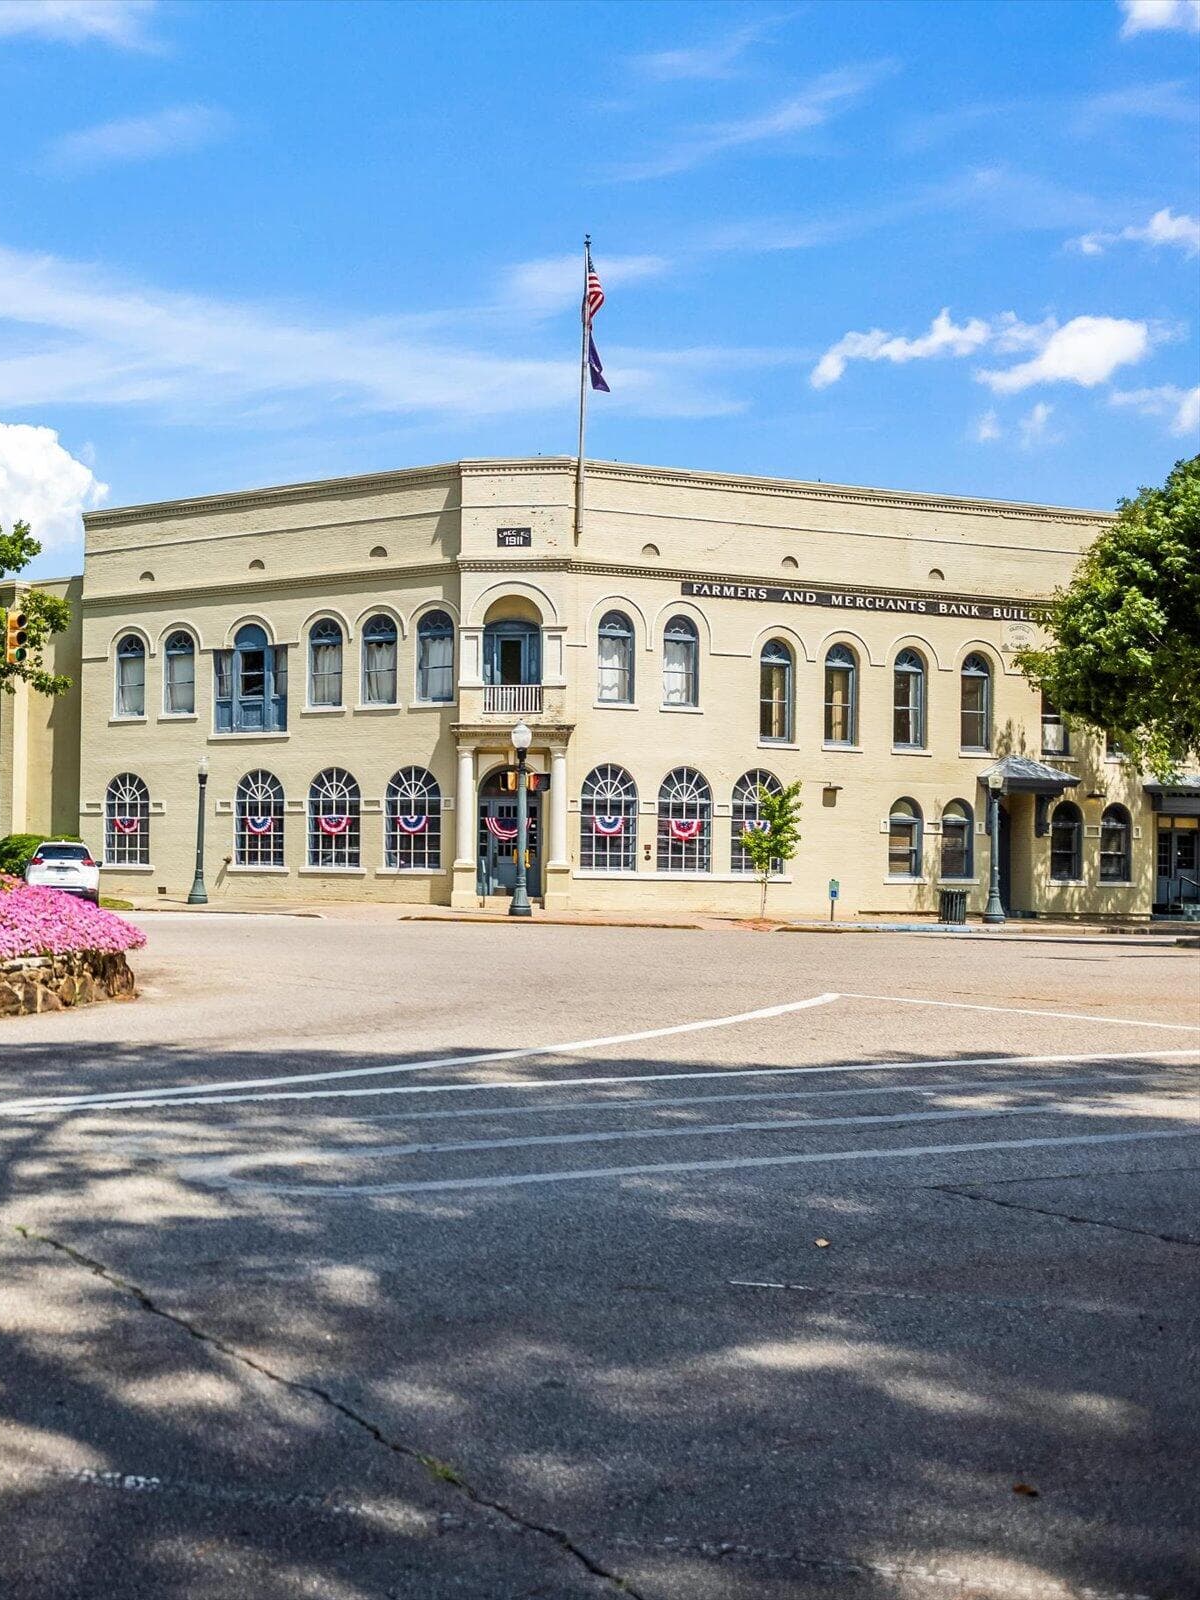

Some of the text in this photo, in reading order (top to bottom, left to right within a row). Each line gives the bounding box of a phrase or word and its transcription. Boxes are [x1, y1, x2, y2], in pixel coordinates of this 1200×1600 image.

[505, 536, 523, 545] 1911
[692, 583, 1054, 622] FARMERS AND MERCHANTS BANK BUILDIN
